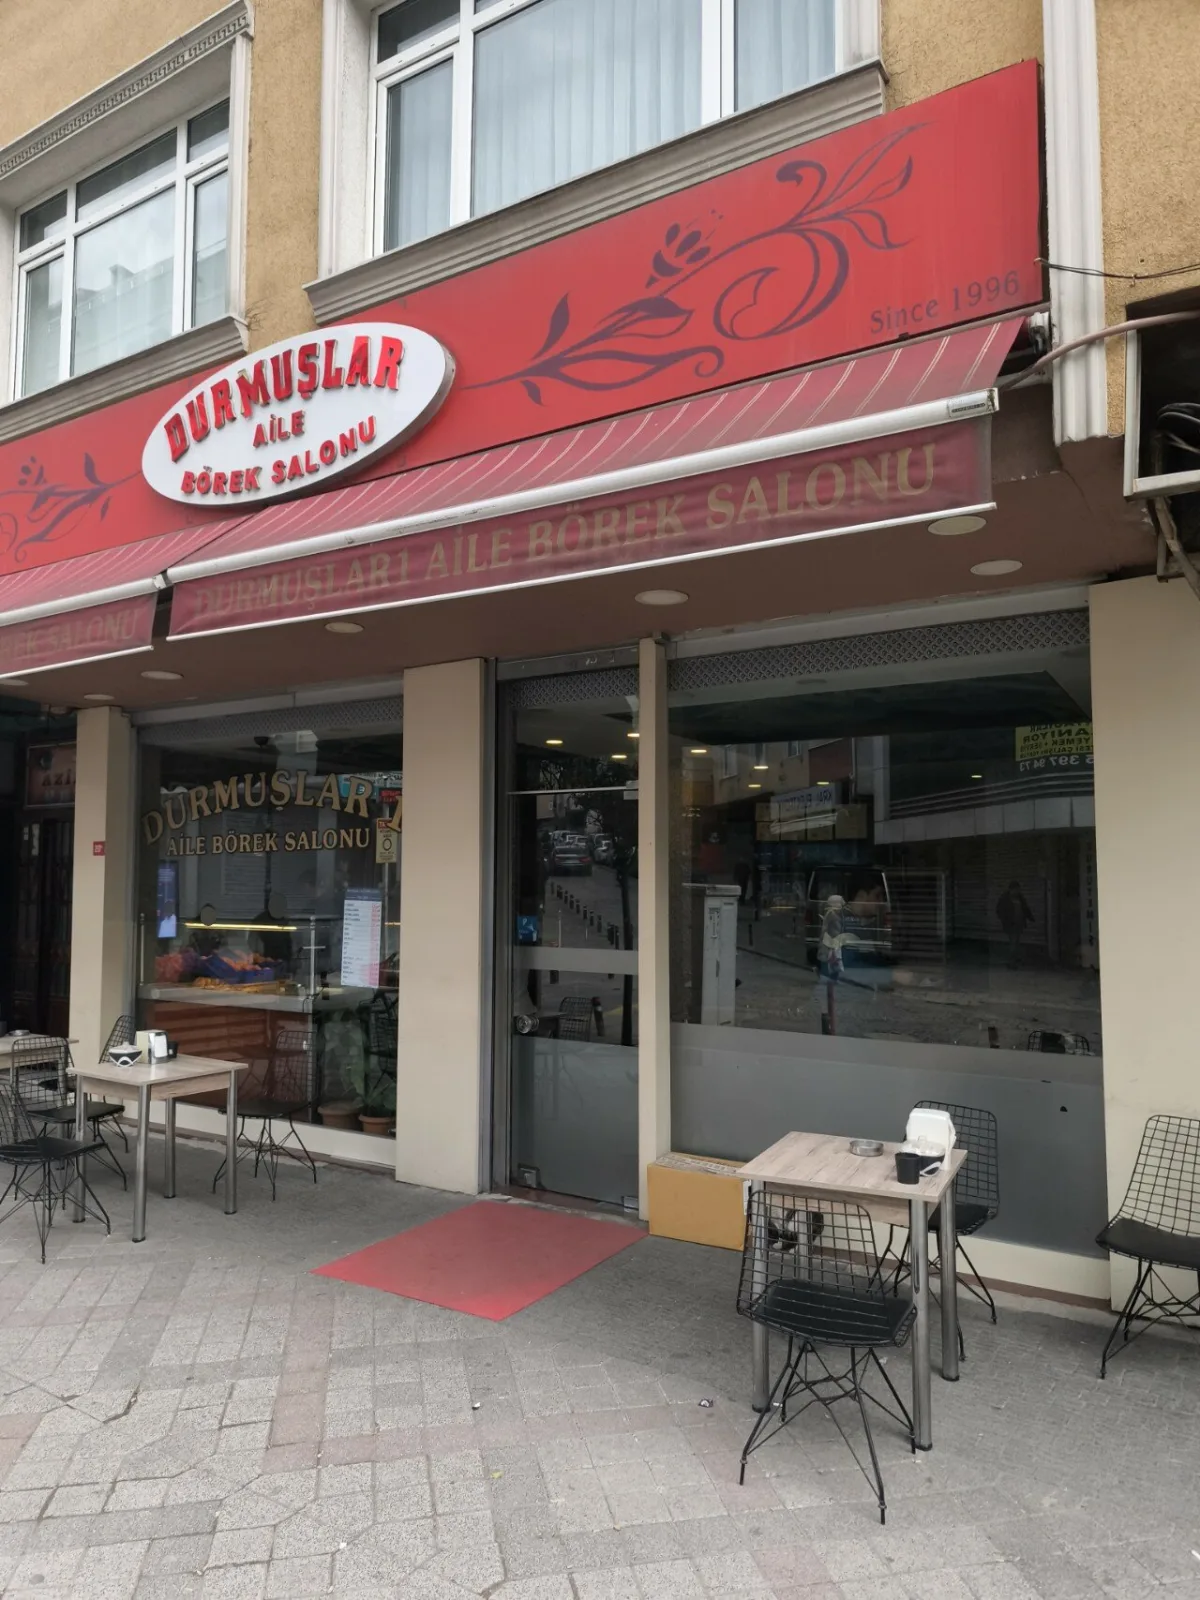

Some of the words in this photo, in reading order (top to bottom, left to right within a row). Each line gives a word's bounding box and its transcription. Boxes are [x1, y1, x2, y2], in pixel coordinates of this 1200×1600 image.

[870, 298, 939, 335] Since
[953, 270, 1020, 312] 1996
[163, 335, 405, 464] DURMUŞLAR
[252, 410, 306, 448] AİLE
[181, 465, 261, 495] BÖREK
[271, 415, 377, 485] SALONU
[424, 524, 512, 580] AİLE
[527, 502, 689, 564] BÖREK
[705, 442, 937, 530] SALONU
[141, 770, 374, 845] DURMUŞLAR
[166, 832, 206, 856] AİLE
[212, 830, 278, 855] BÖREK
[284, 828, 370, 852] SALONU
